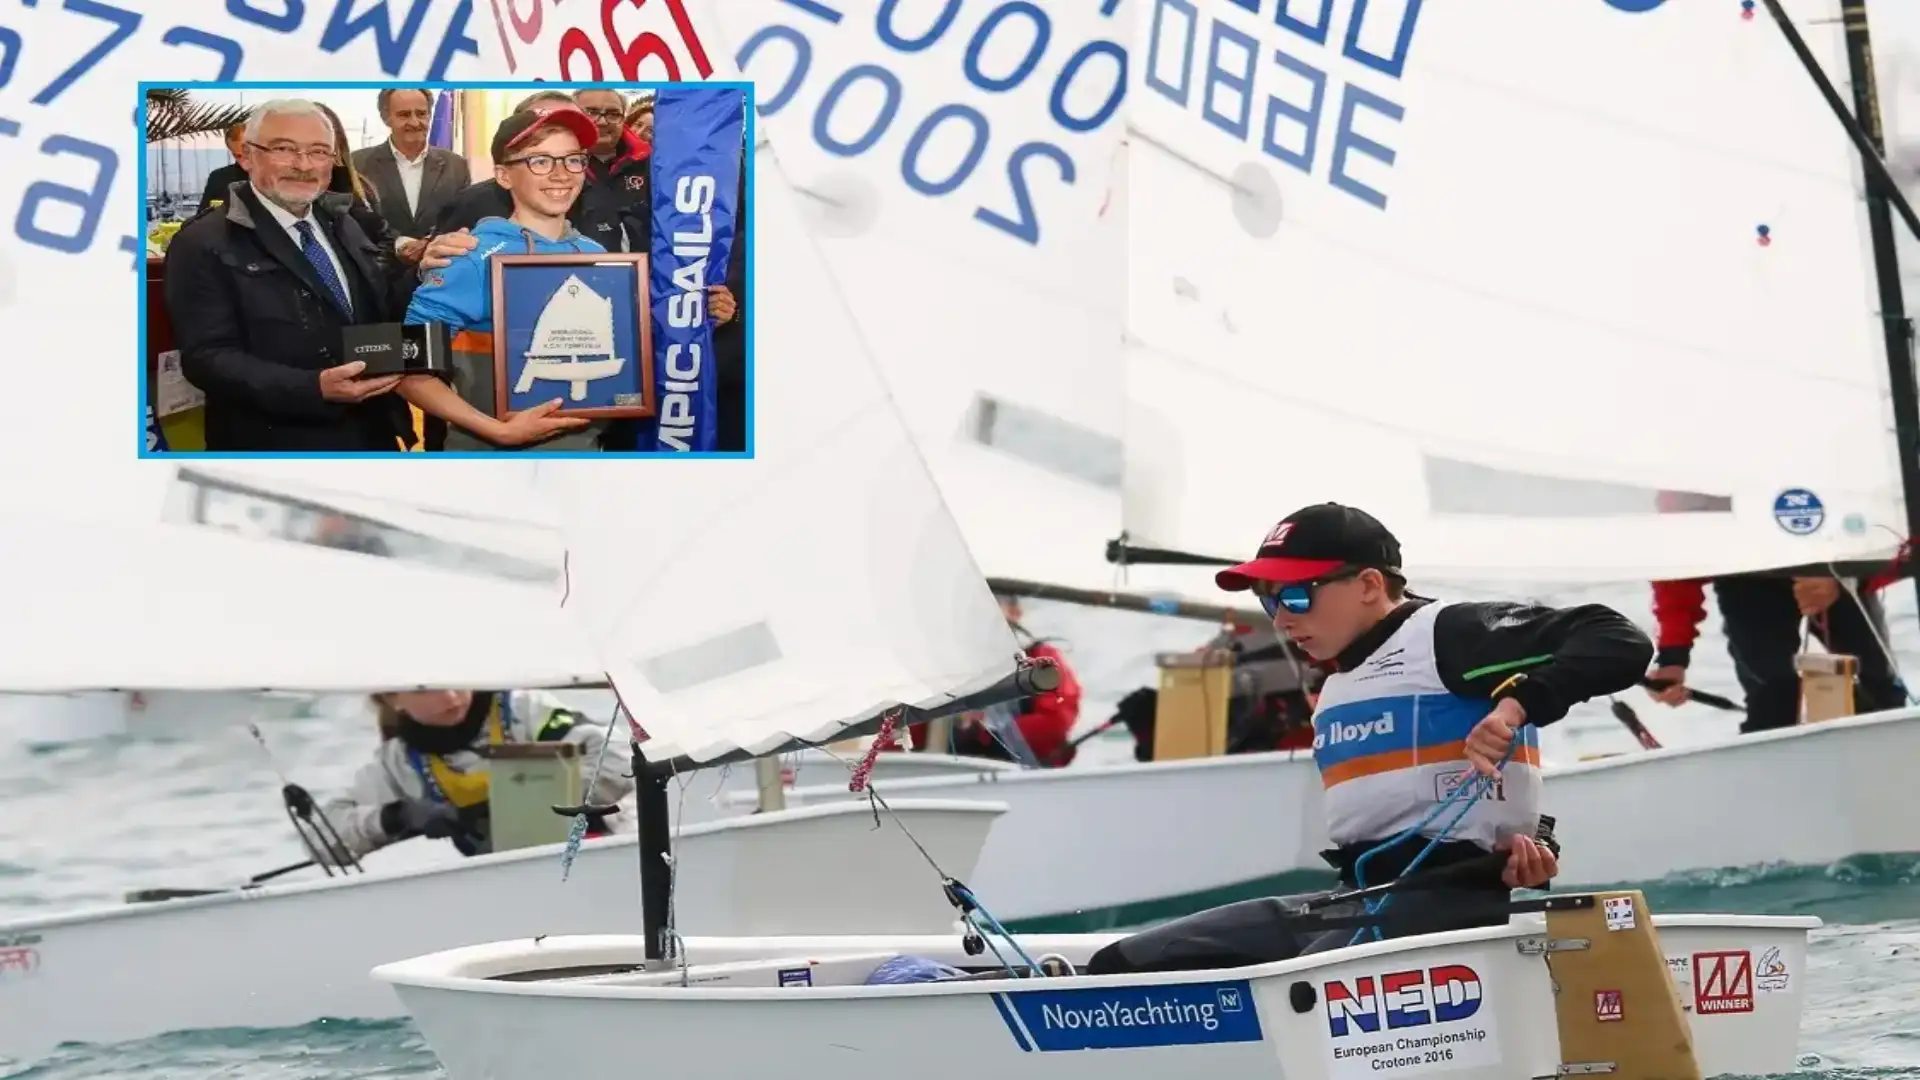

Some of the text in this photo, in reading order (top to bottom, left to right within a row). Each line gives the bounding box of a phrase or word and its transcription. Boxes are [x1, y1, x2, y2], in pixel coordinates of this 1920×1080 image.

[667, 175, 716, 329] SAILS
[1329, 711, 1395, 746] lloyd
[1041, 996, 1220, 1031] NovaYachting
[1324, 964, 1483, 1038] NED
[1701, 999, 1750, 1012] WINNER
[1333, 1027, 1487, 1060] European Championship
[1371, 1048, 1454, 1071] Crotone 2016
